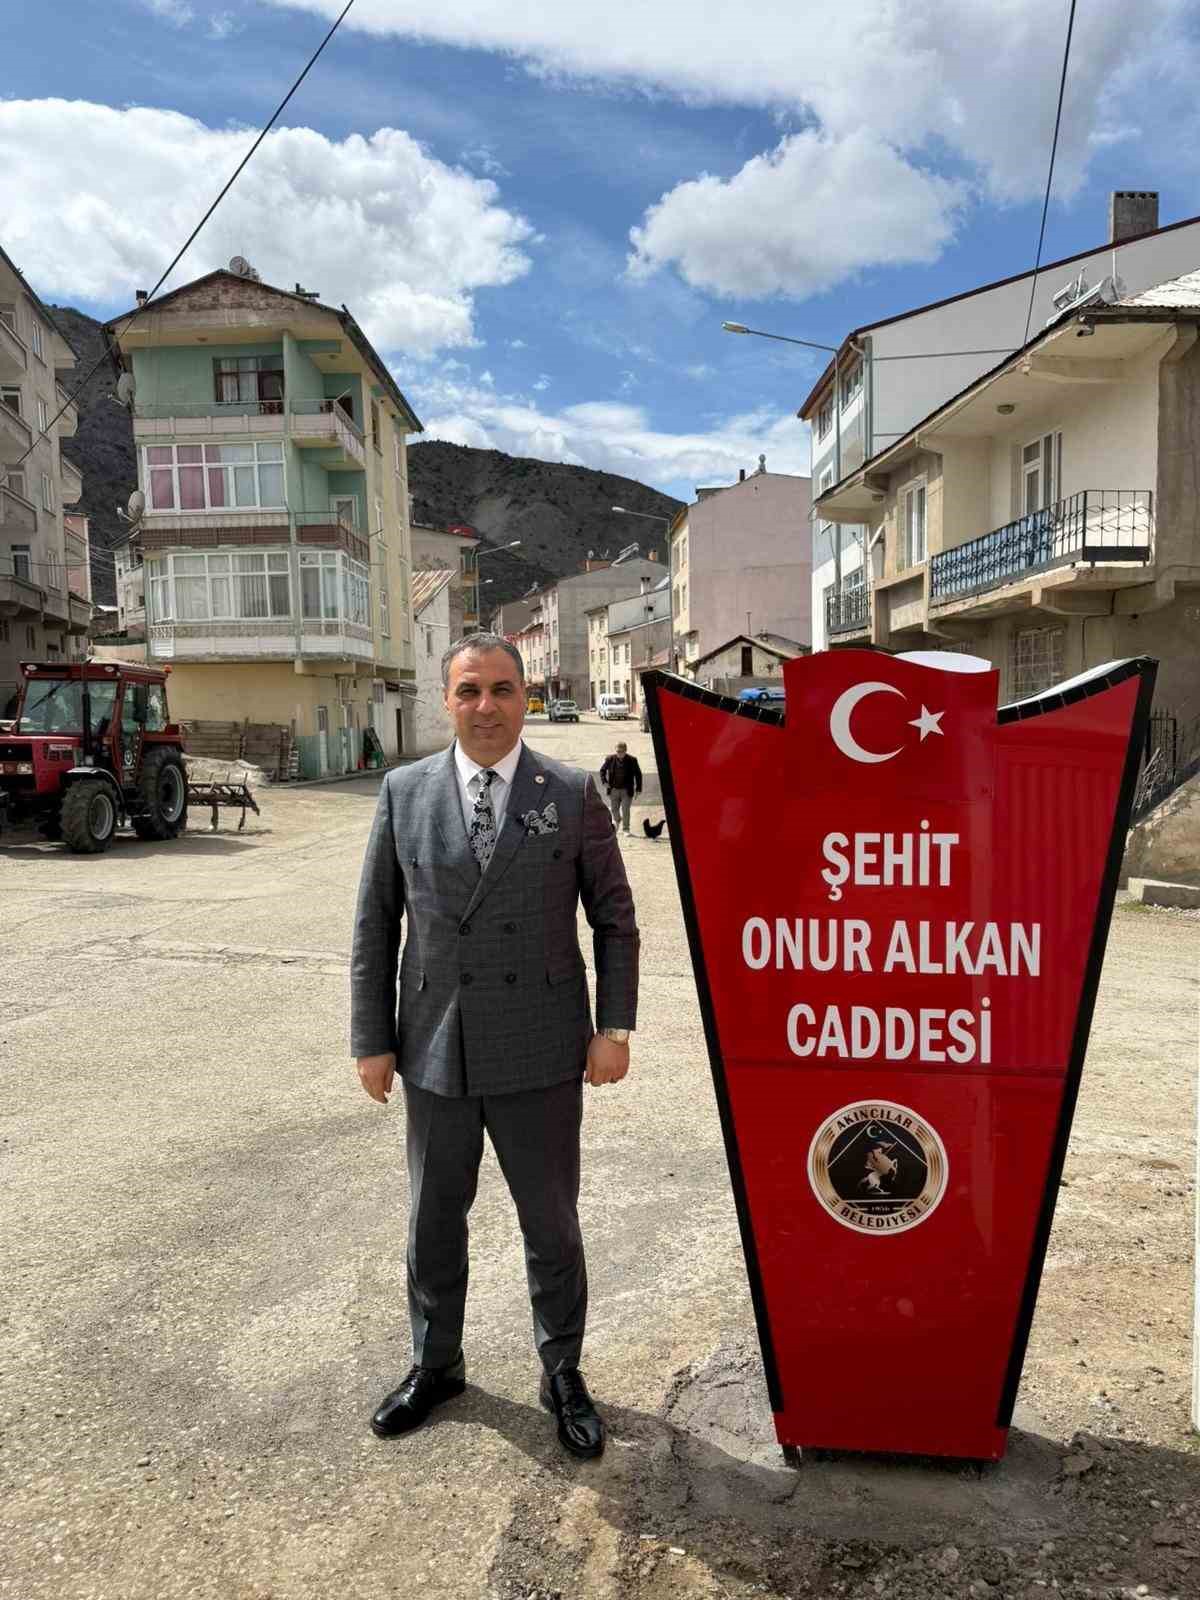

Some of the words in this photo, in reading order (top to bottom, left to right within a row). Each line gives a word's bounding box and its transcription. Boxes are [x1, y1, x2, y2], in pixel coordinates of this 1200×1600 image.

[821, 819, 960, 901] ŞEHİT
[741, 916, 873, 973] ONUR
[883, 920, 1041, 977] ALKAN
[786, 996, 992, 1064] CADDESİ
[836, 1108, 913, 1130] AKINCILAR
